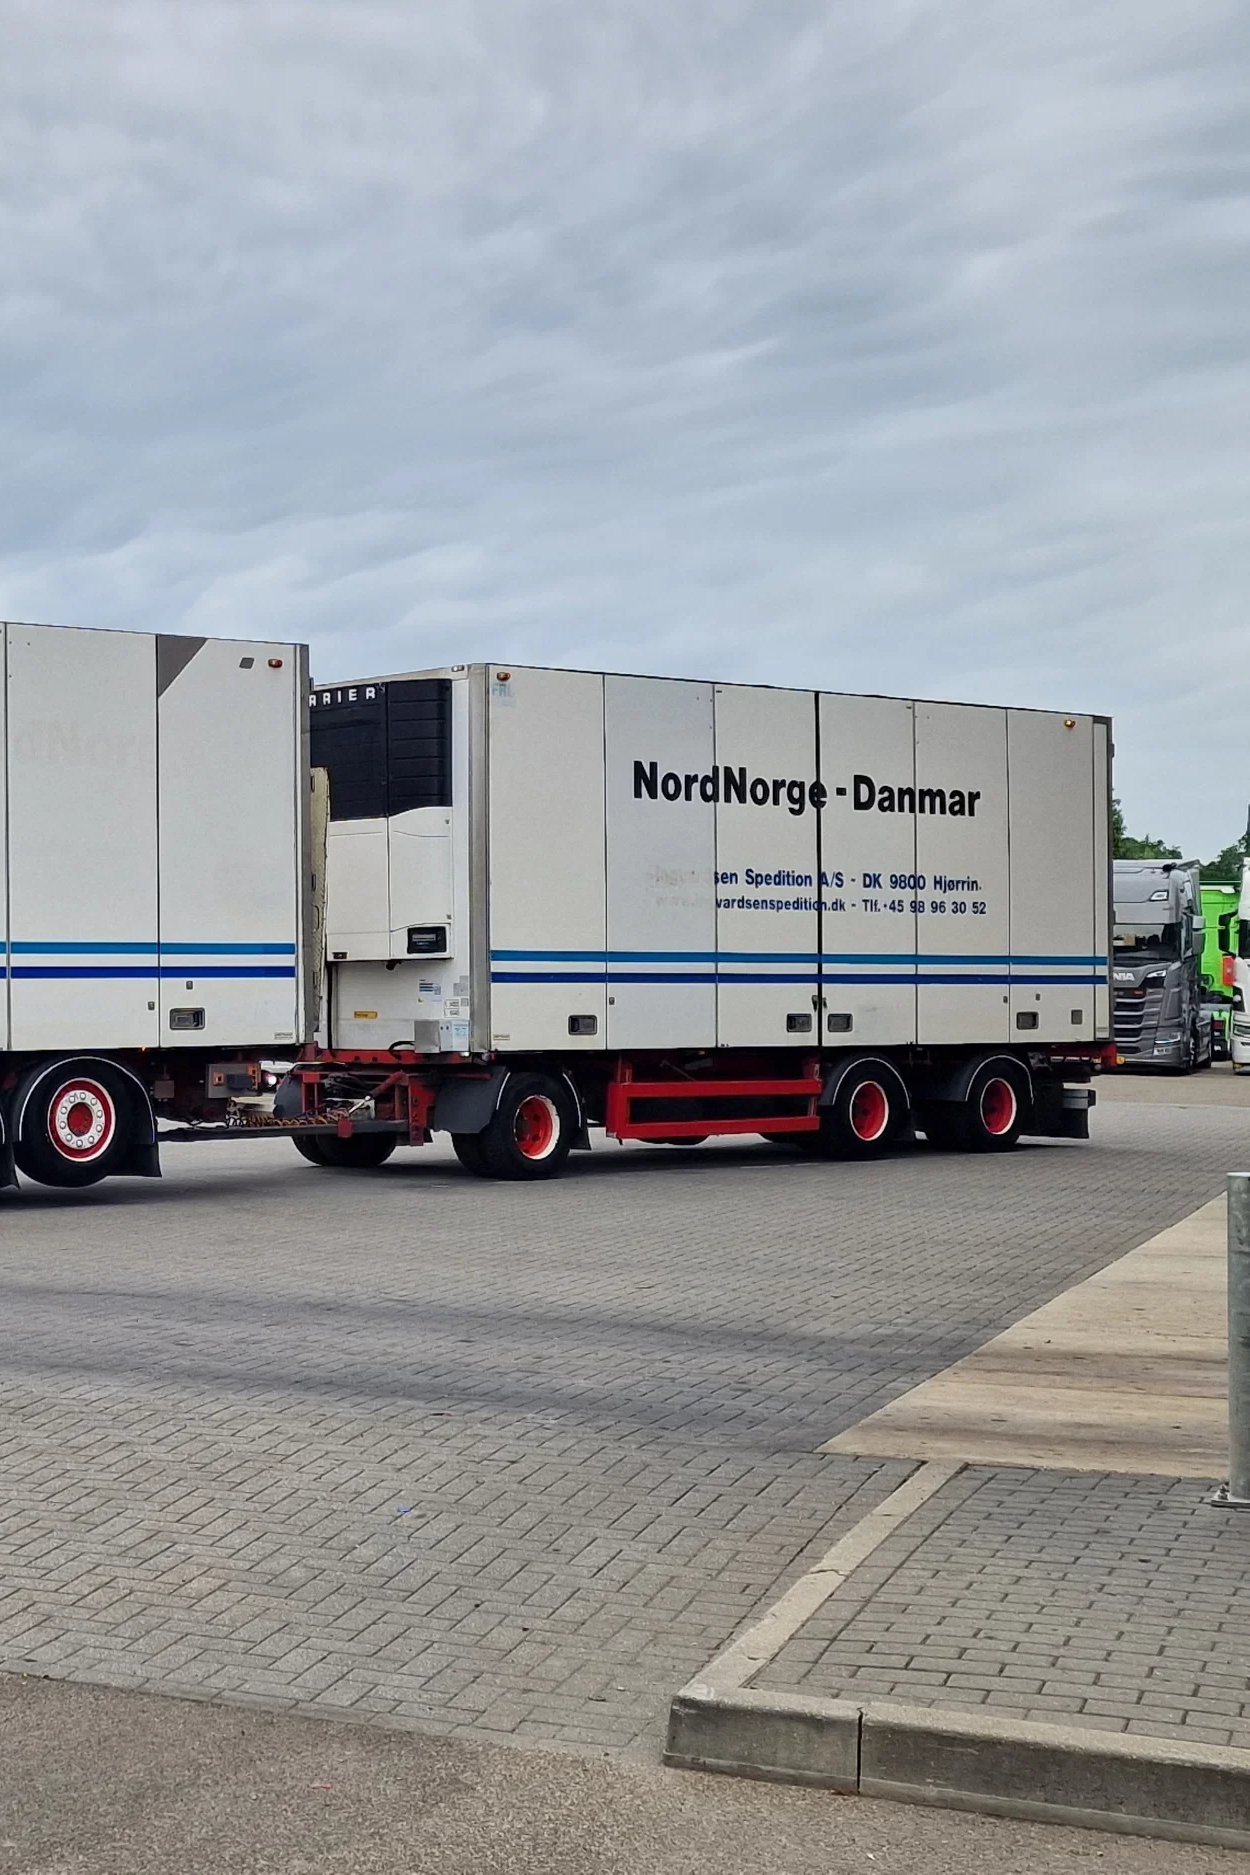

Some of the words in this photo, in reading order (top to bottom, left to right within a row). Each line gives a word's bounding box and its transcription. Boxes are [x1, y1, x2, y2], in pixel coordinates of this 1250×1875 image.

[633, 760, 827, 816] NordNorge
[853, 774, 981, 817] Danmar
[745, 868, 812, 888] Spedition
[819, 871, 844, 888] A/S
[862, 873, 883, 889] DK
[889, 874, 926, 890] 9800
[909, 900, 925, 913] 98
[930, 901, 946, 914] 96
[951, 901, 967, 914] 30
[972, 901, 987, 915] 52
